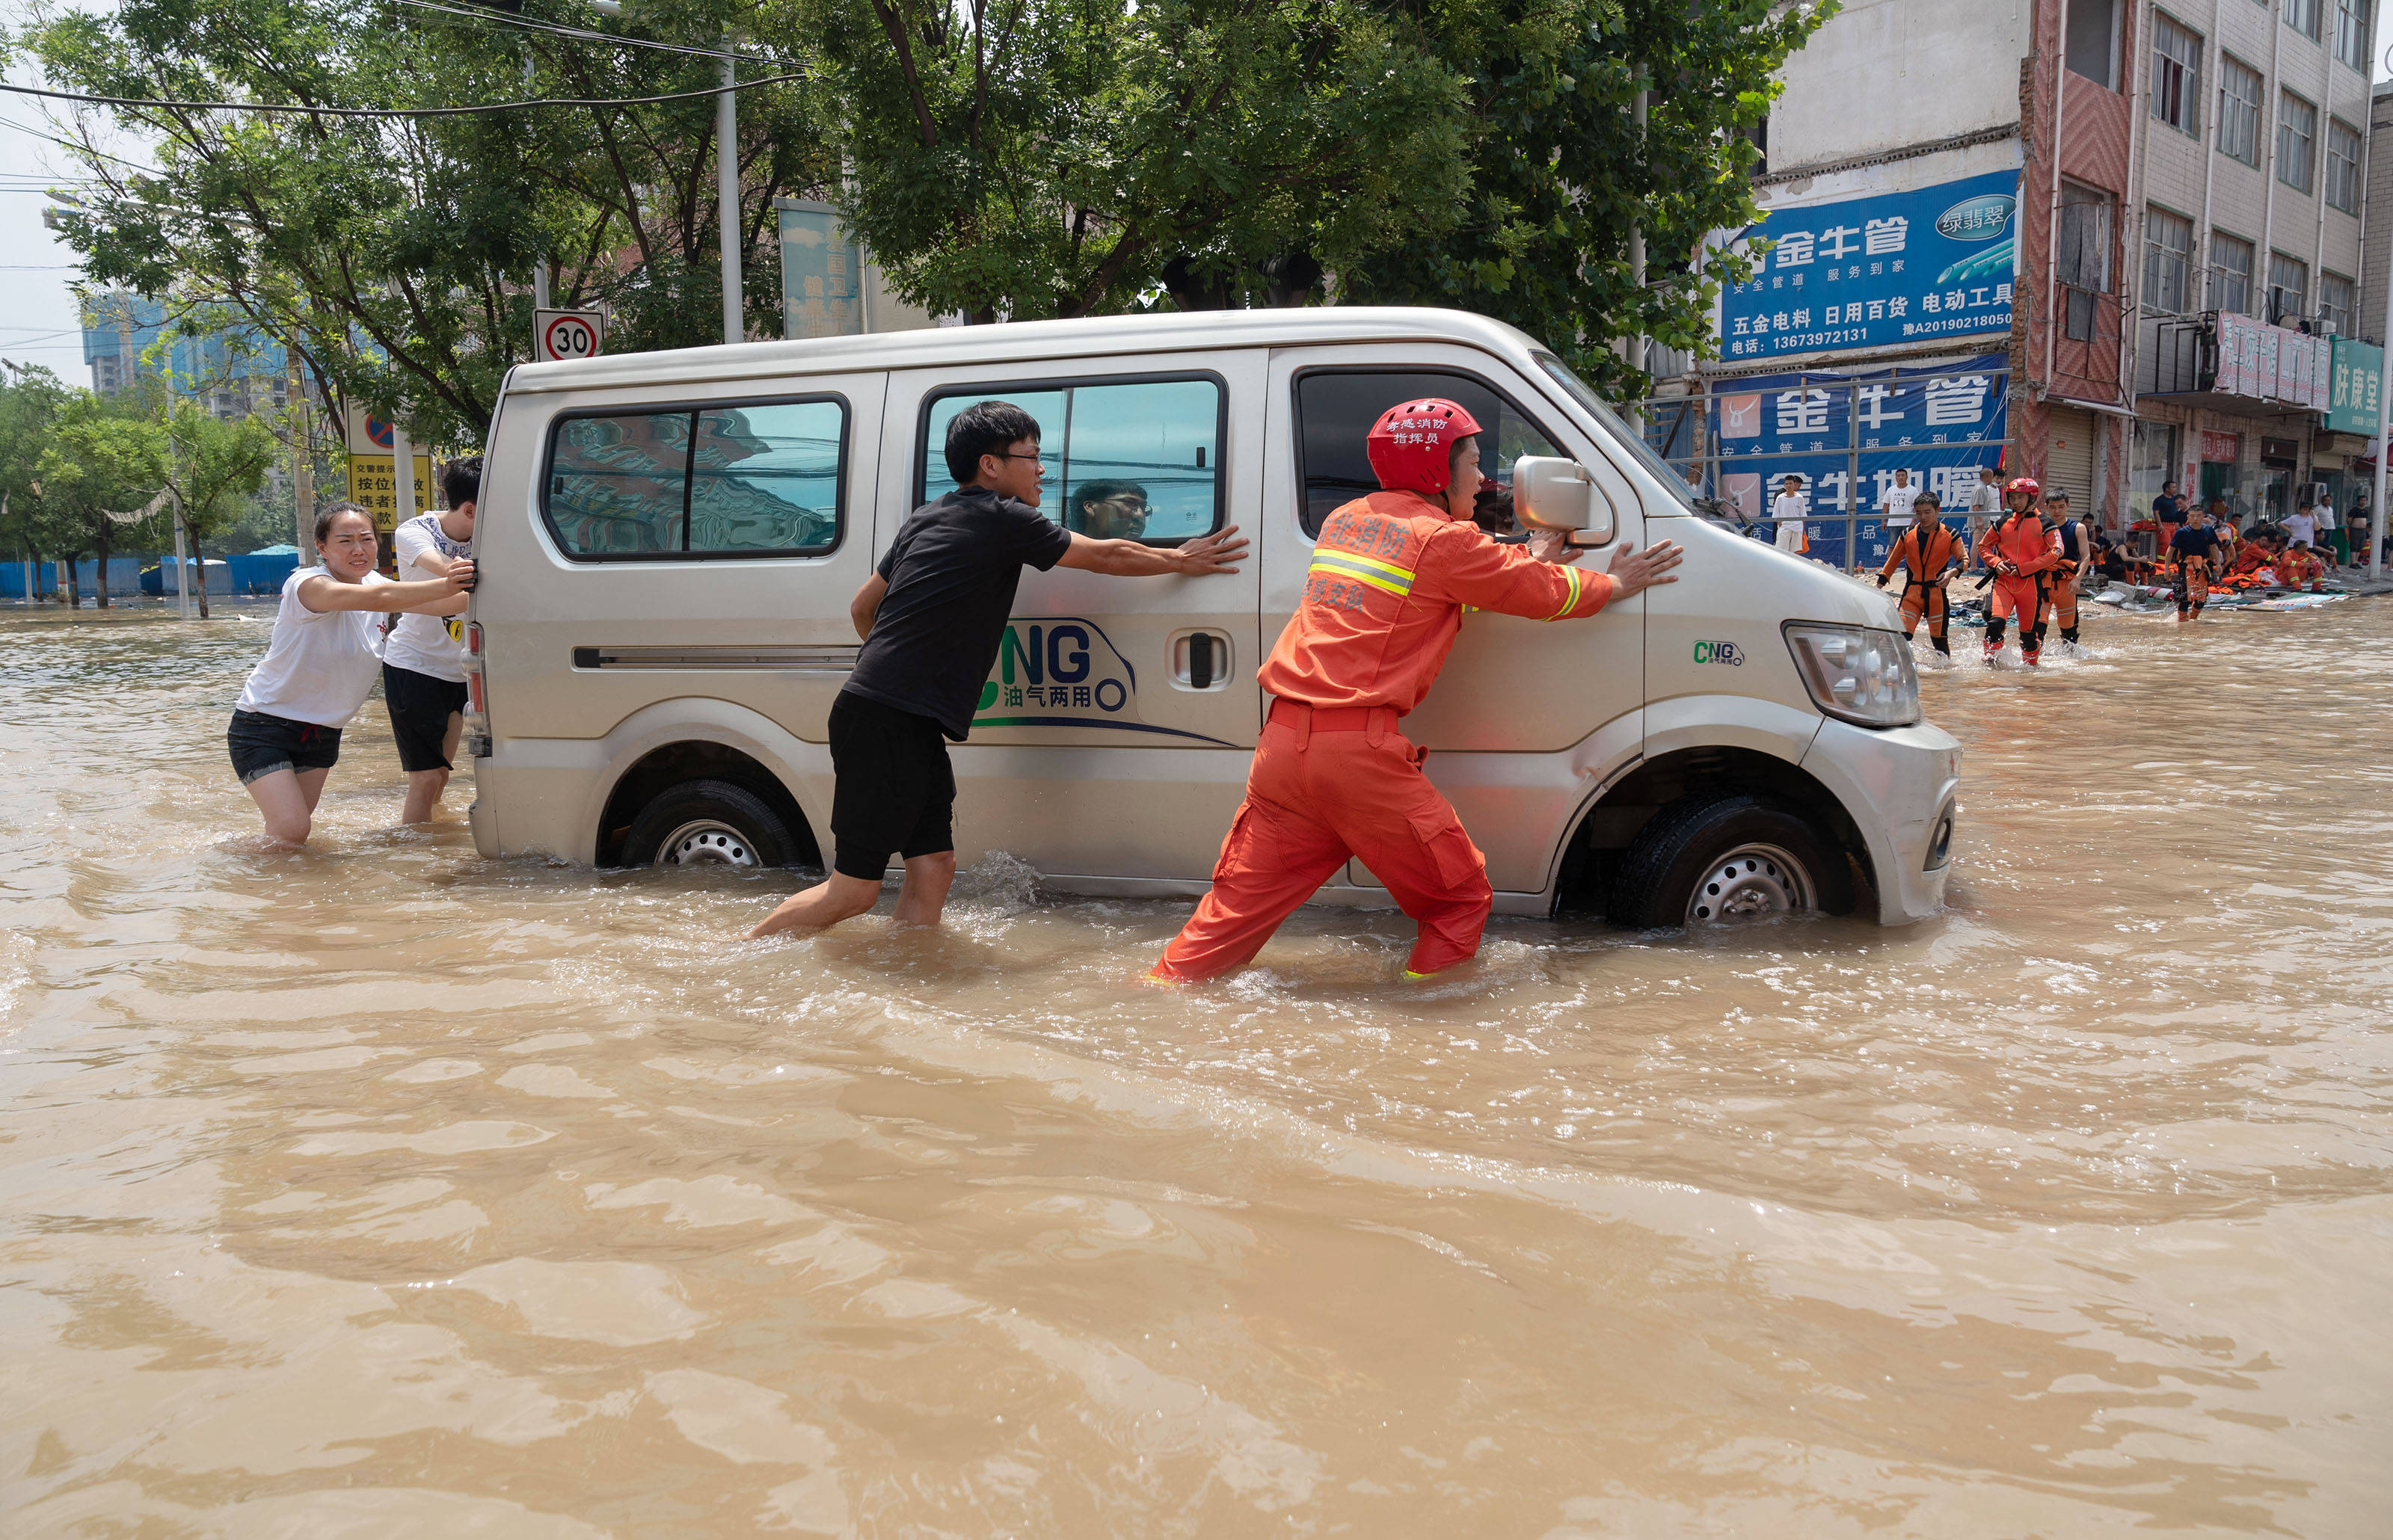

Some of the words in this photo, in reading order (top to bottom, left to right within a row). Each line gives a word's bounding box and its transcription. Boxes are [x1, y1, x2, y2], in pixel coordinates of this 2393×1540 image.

[1942, 205, 2004, 232] 绿翡翠
[1775, 216, 1908, 268] 金牛管
[1733, 273, 1804, 295] 安全管道
[1828, 259, 1905, 282] 服务到家
[1733, 307, 1810, 336] 五金电料
[1825, 296, 1908, 326] 日用百货
[1923, 283, 2013, 313] 电动工具
[1902, 312, 2012, 336] 豫A20190218050
[557, 327, 587, 353] 30
[1773, 327, 1867, 349] 13673972131
[2333, 363, 2378, 412] 肤康堂
[1776, 375, 1989, 435] 金牛管
[1386, 418, 1448, 432] 孝感消防
[1393, 433, 1439, 445] 指挥员
[357, 464, 396, 473] 交警提示
[1694, 641, 1733, 664] CNG
[1004, 686, 1091, 707] 油气两用
